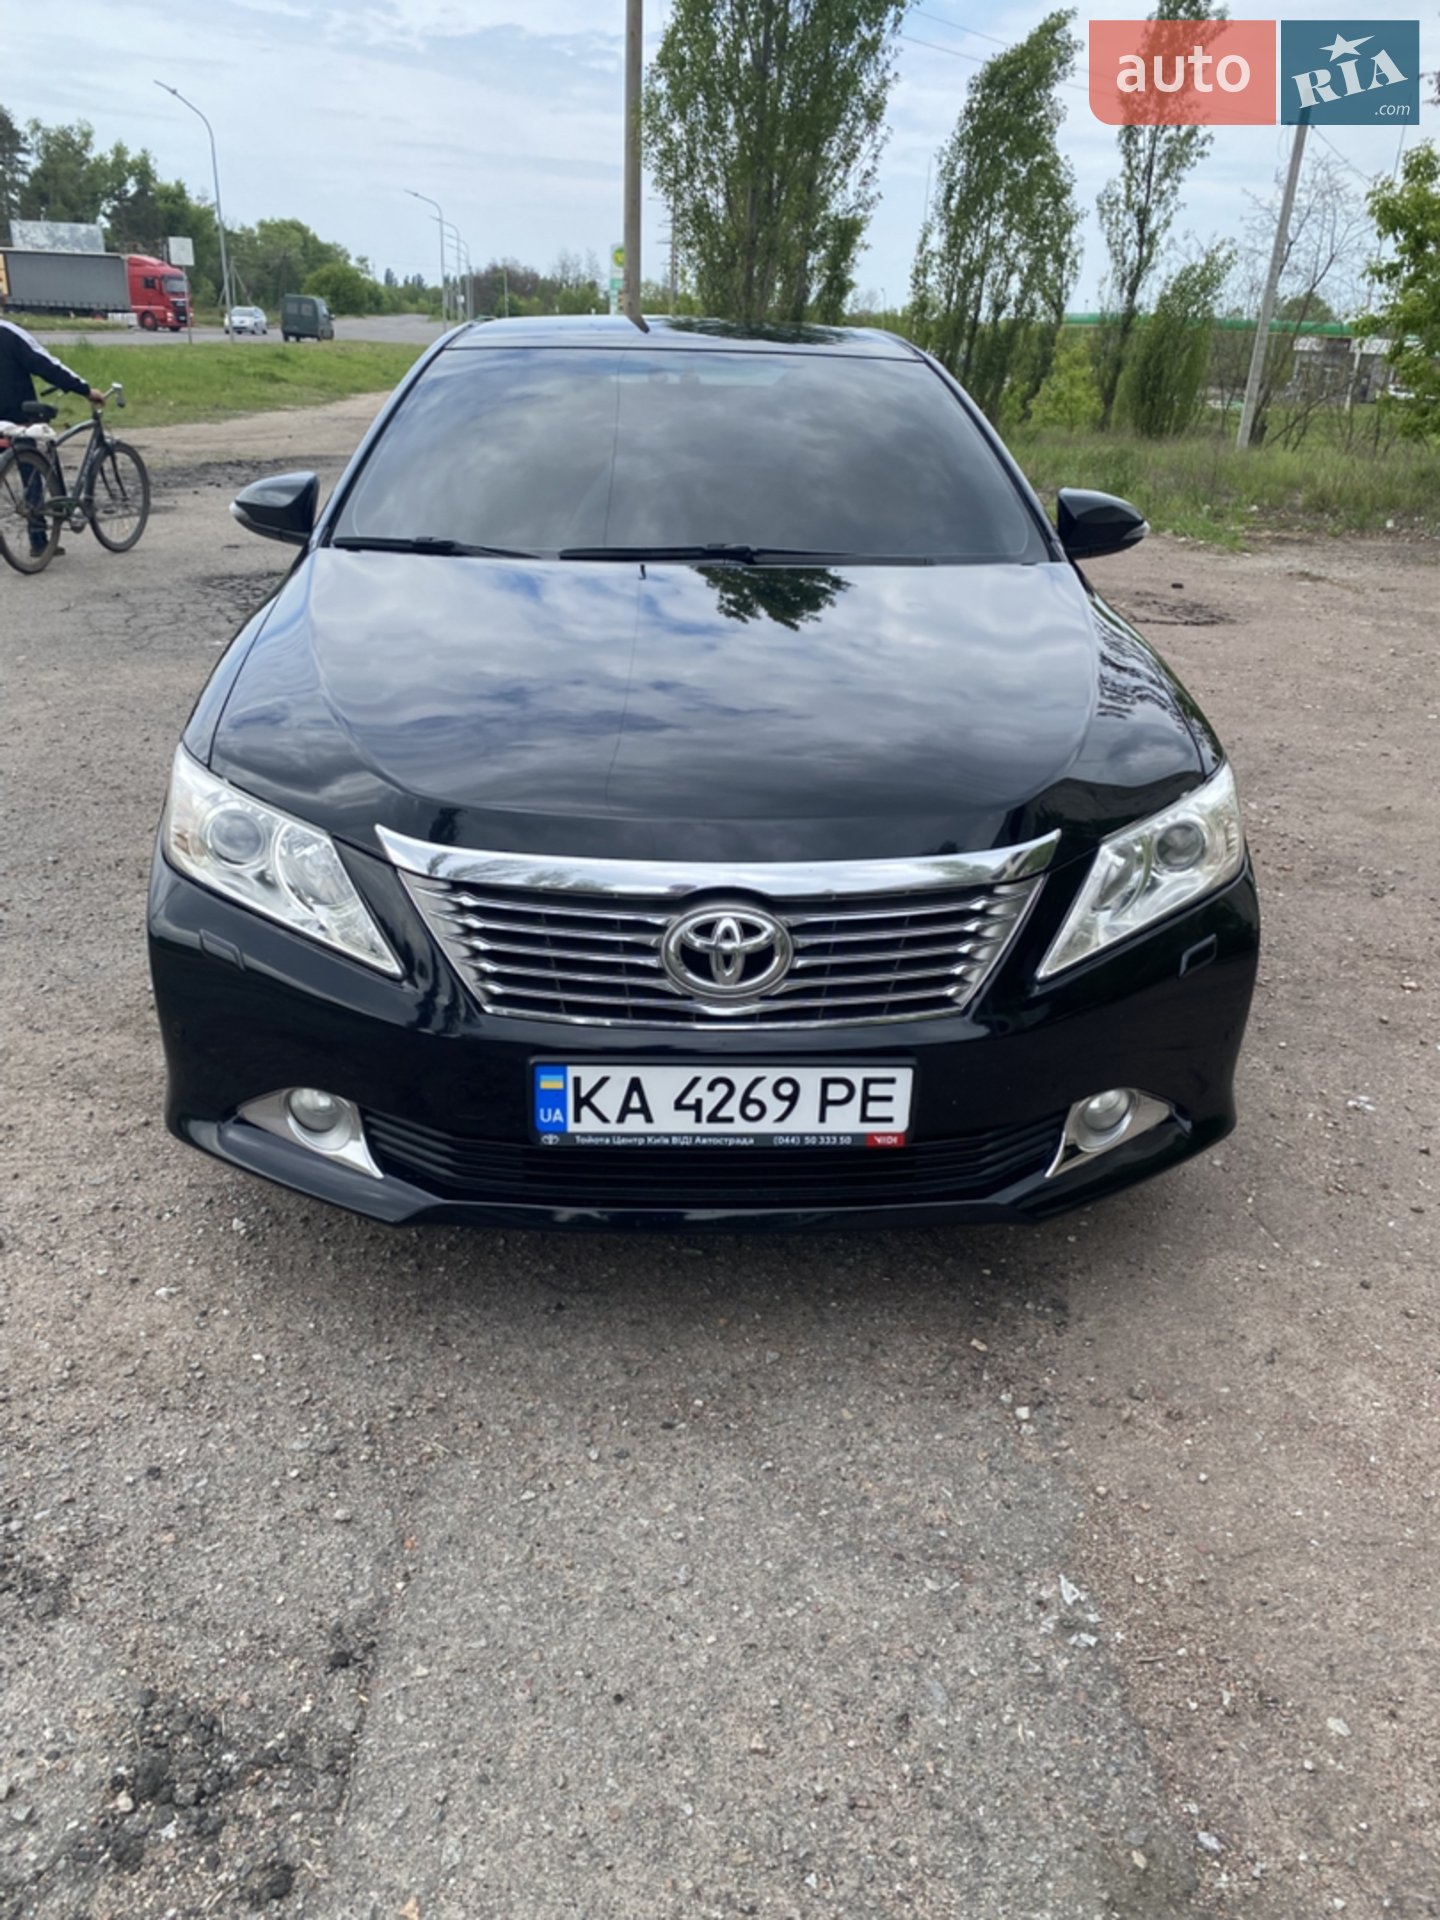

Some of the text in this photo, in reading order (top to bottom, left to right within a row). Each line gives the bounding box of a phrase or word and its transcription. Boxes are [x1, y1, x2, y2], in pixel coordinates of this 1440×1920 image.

[573, 1076, 897, 1124] KA 4269 PE
[540, 1108, 564, 1123] UA
[575, 1135, 610, 1146] Тойота
[612, 1135, 645, 1146] Центр
[694, 1135, 754, 1147] Автострада
[773, 1135, 800, 1147] (044)
[804, 1136, 817, 1146] 50
